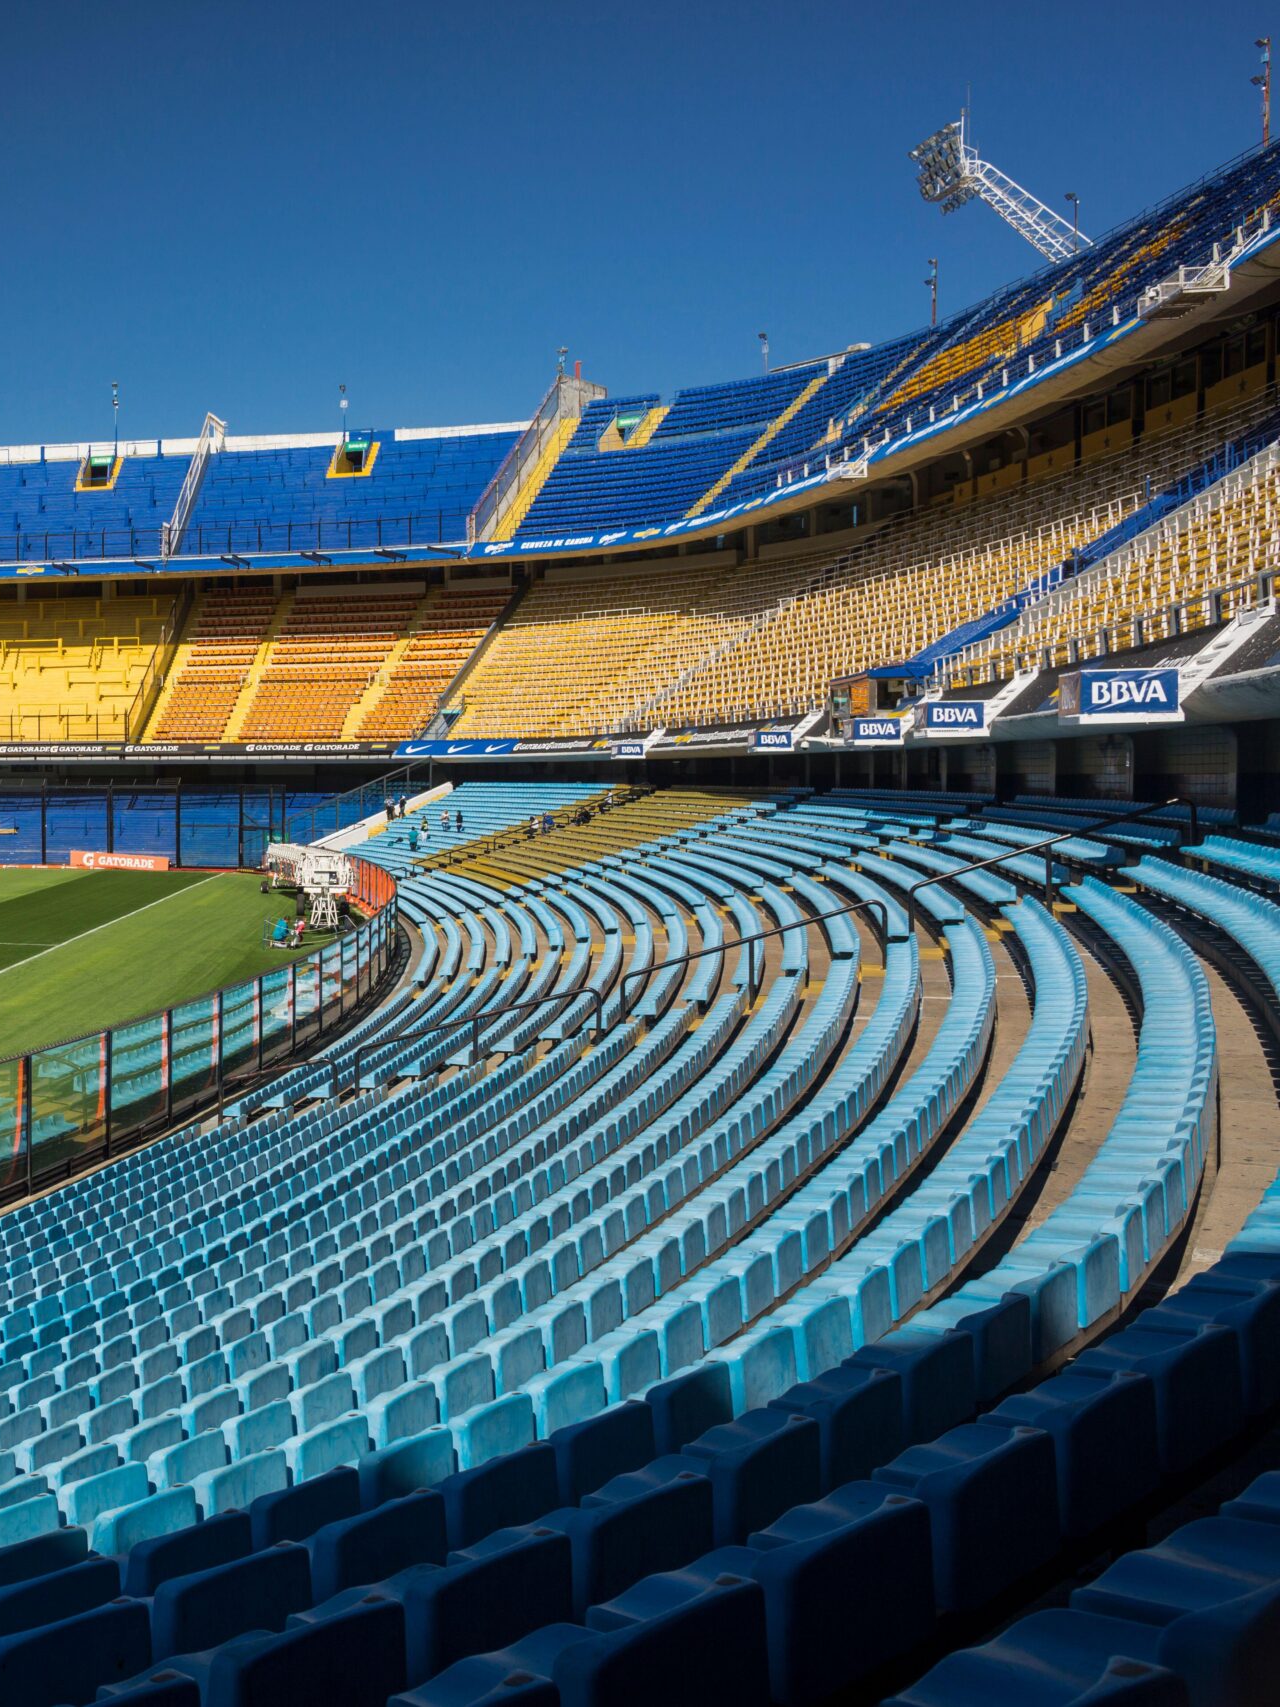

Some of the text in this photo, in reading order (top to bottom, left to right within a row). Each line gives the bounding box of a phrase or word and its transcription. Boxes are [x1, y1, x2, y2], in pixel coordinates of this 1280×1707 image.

[553, 539, 564, 548] DE
[1091, 680, 1168, 705] BBVA
[932, 708, 978, 723] BBVA
[859, 723, 895, 736] BBVA
[761, 733, 788, 744] BBVA
[313, 743, 360, 751] GATORADE
[621, 746, 641, 754] BBVA
[83, 853, 154, 869] G GATORADE
